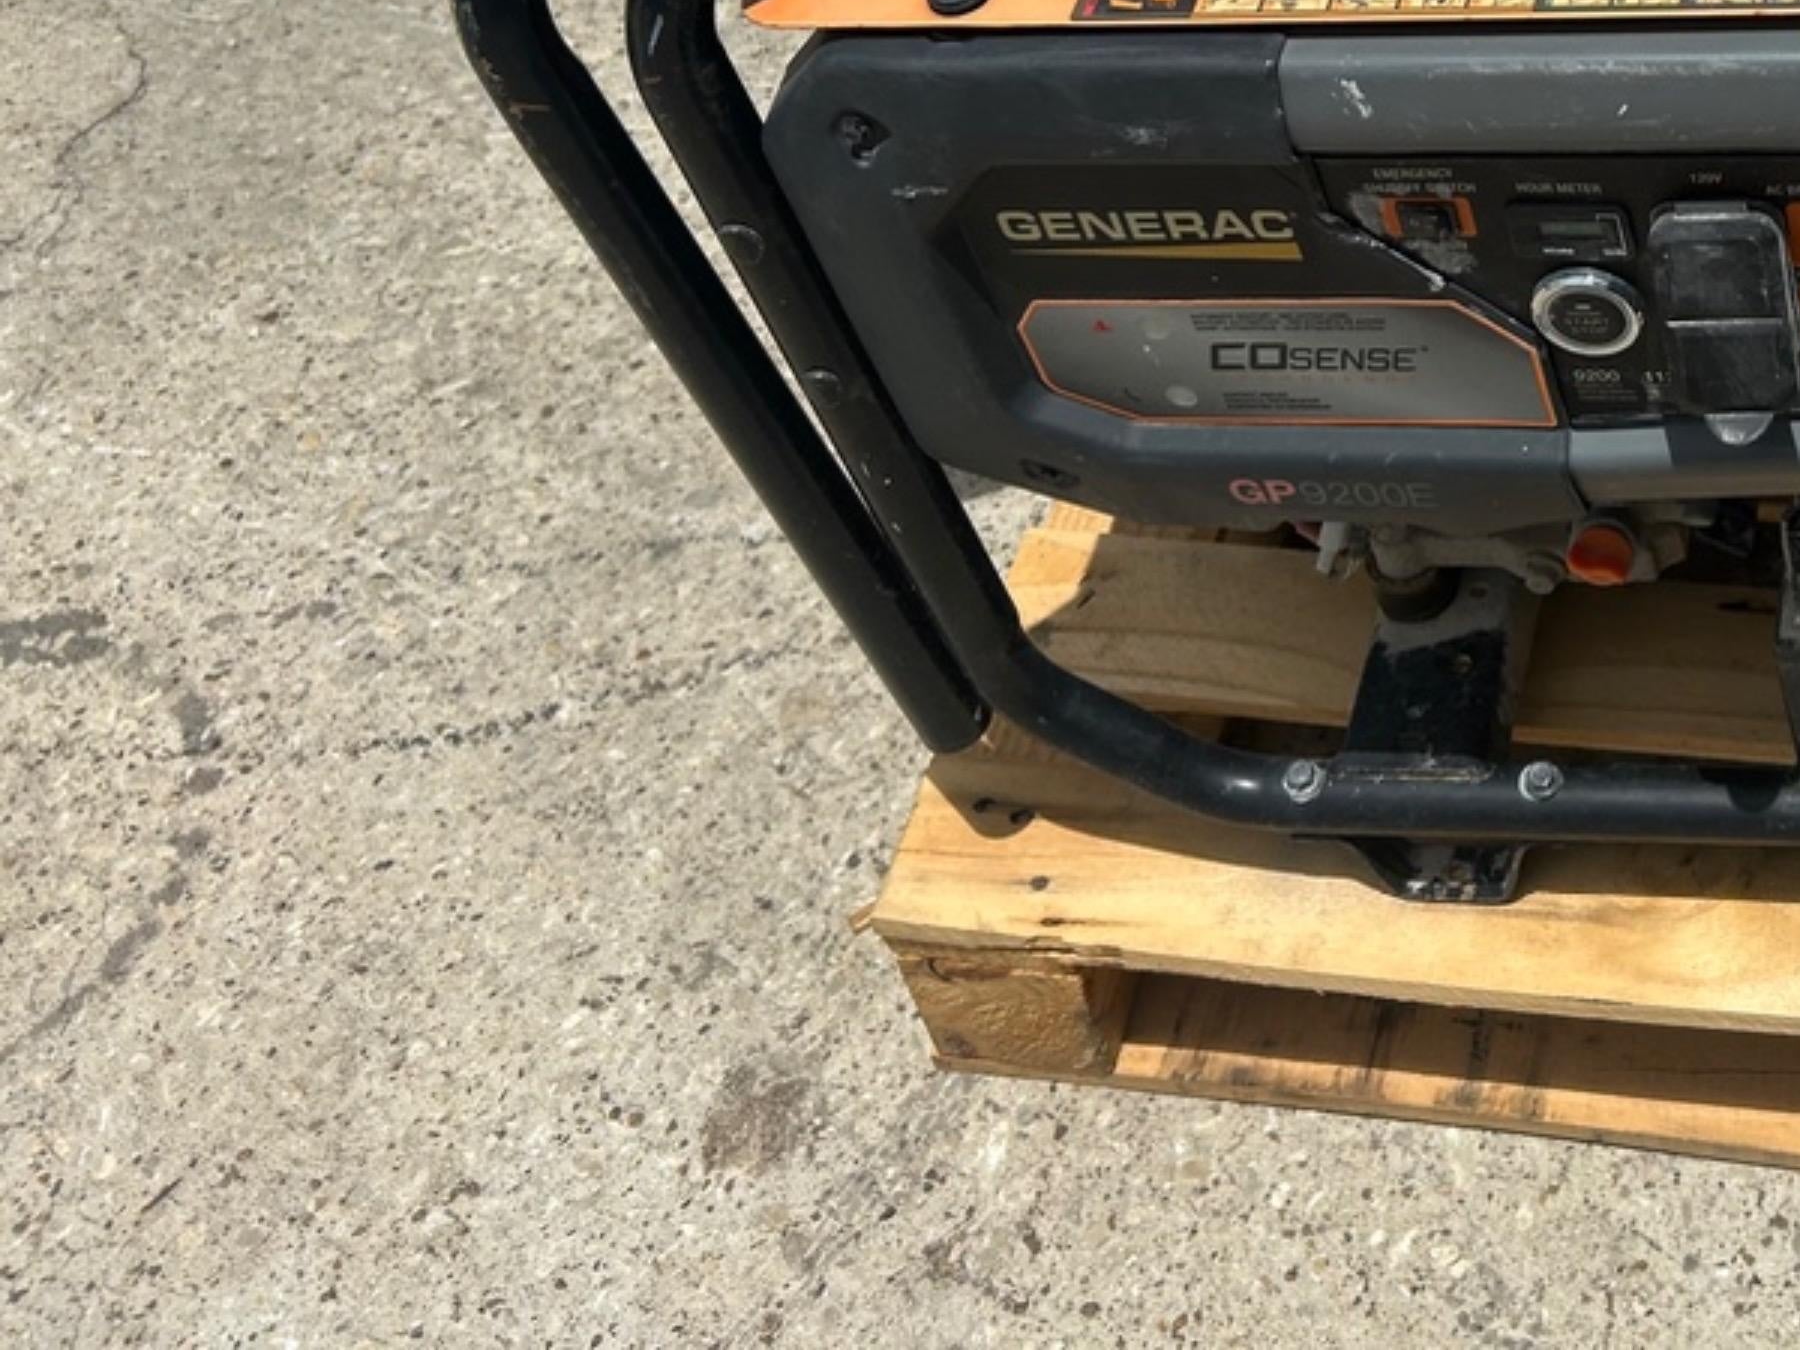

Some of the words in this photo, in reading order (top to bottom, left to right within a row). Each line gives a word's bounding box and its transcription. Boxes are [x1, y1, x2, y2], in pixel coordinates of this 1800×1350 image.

[1372, 167, 1453, 180] EMERGENCY
[1689, 172, 1724, 185] 120V
[1514, 182, 1554, 195] HOUR
[1556, 183, 1603, 196] METER
[994, 208, 1295, 241] GENERAC
[1572, 368, 1621, 382] 9200
[1228, 478, 1440, 508] GP9200E
